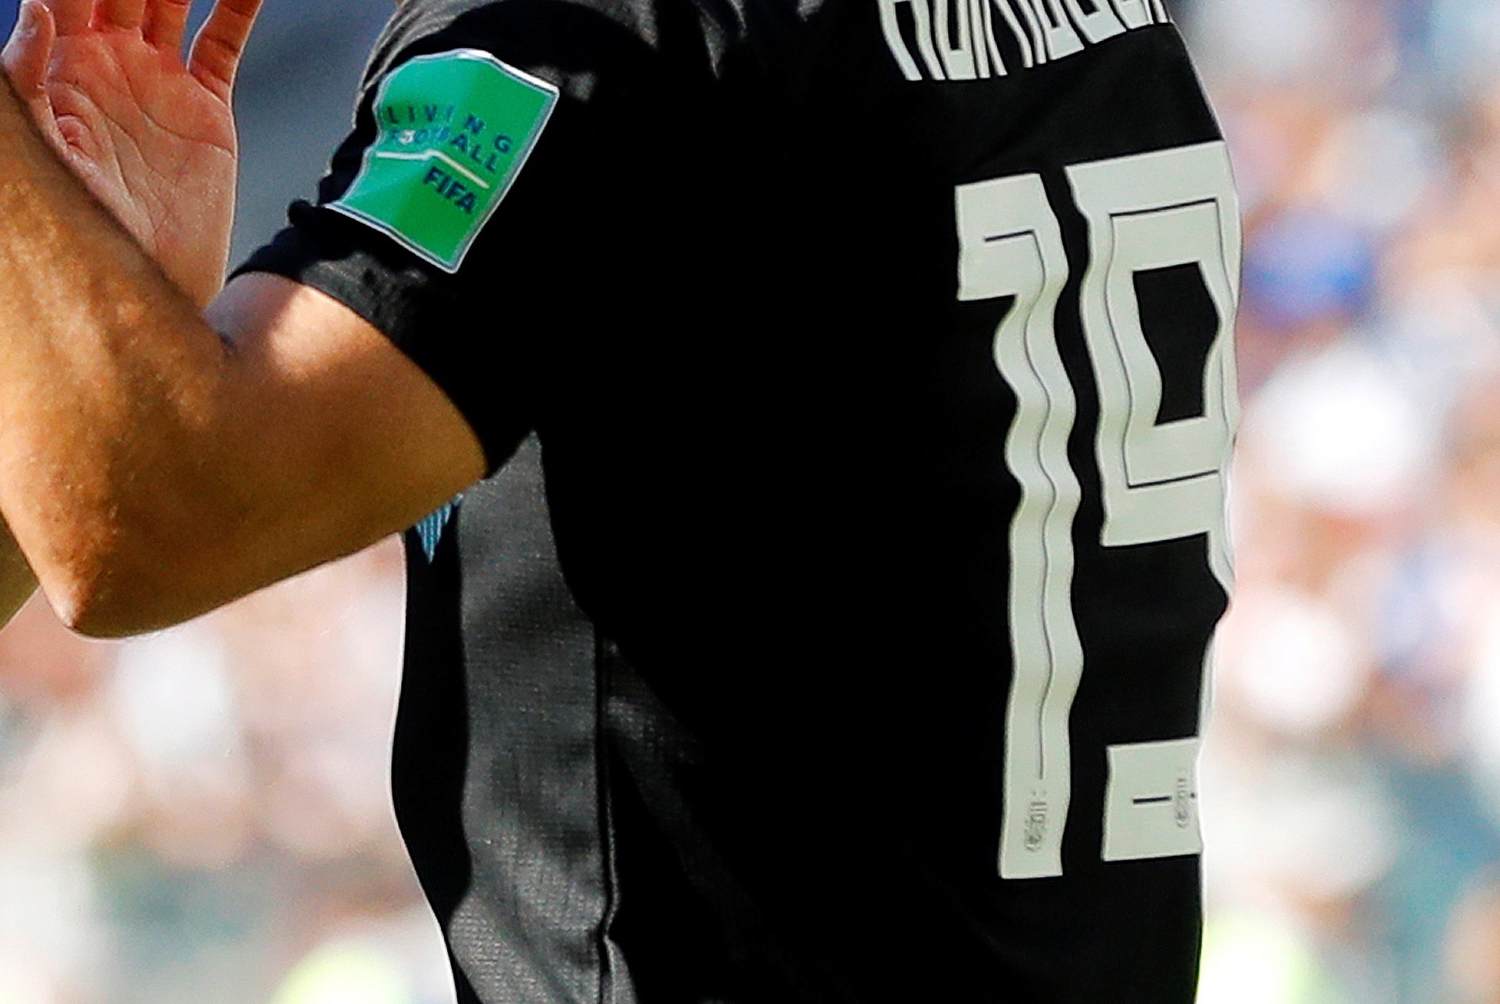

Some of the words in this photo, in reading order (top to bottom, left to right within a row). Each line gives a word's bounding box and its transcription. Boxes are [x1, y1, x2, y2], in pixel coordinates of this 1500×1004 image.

[386, 104, 514, 155] LIVING
[424, 167, 476, 214] FIFA
[953, 140, 1242, 880] 19
